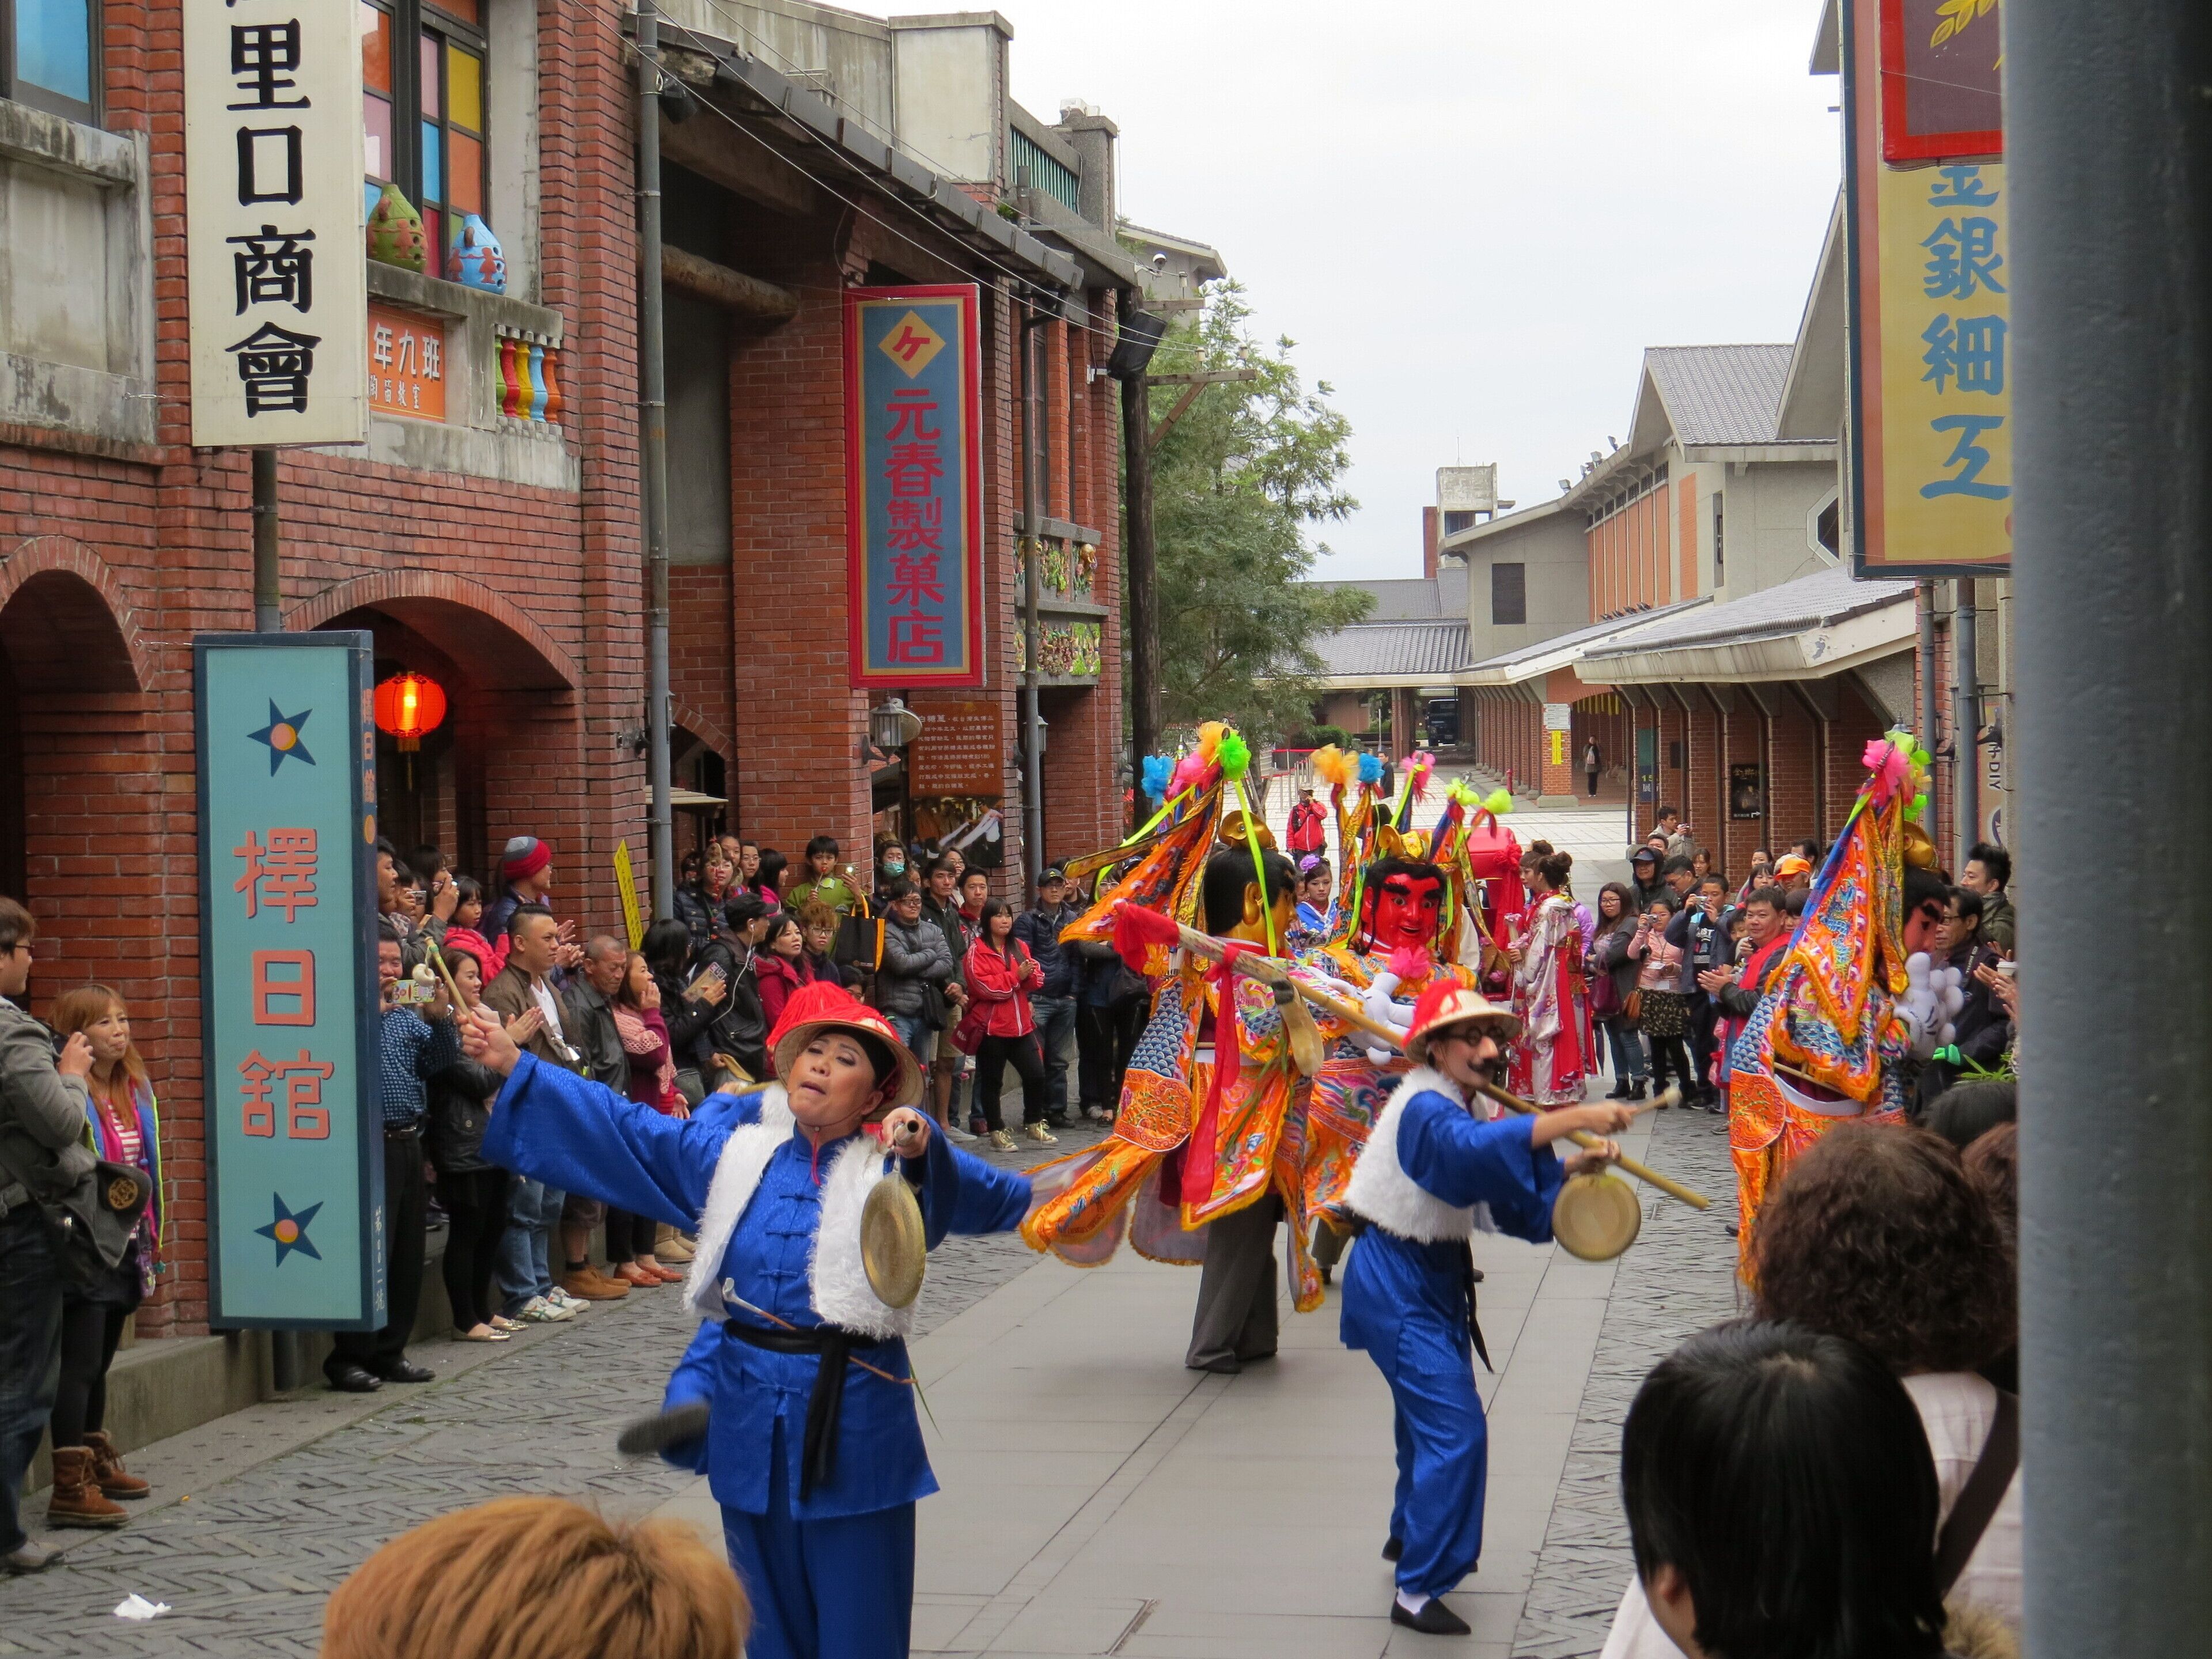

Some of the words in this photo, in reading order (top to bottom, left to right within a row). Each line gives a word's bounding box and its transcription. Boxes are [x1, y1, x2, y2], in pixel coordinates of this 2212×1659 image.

[225, 0, 322, 419] 里口商會
[374, 323, 440, 379] 年九班
[233, 828, 335, 1141] 擇日館
